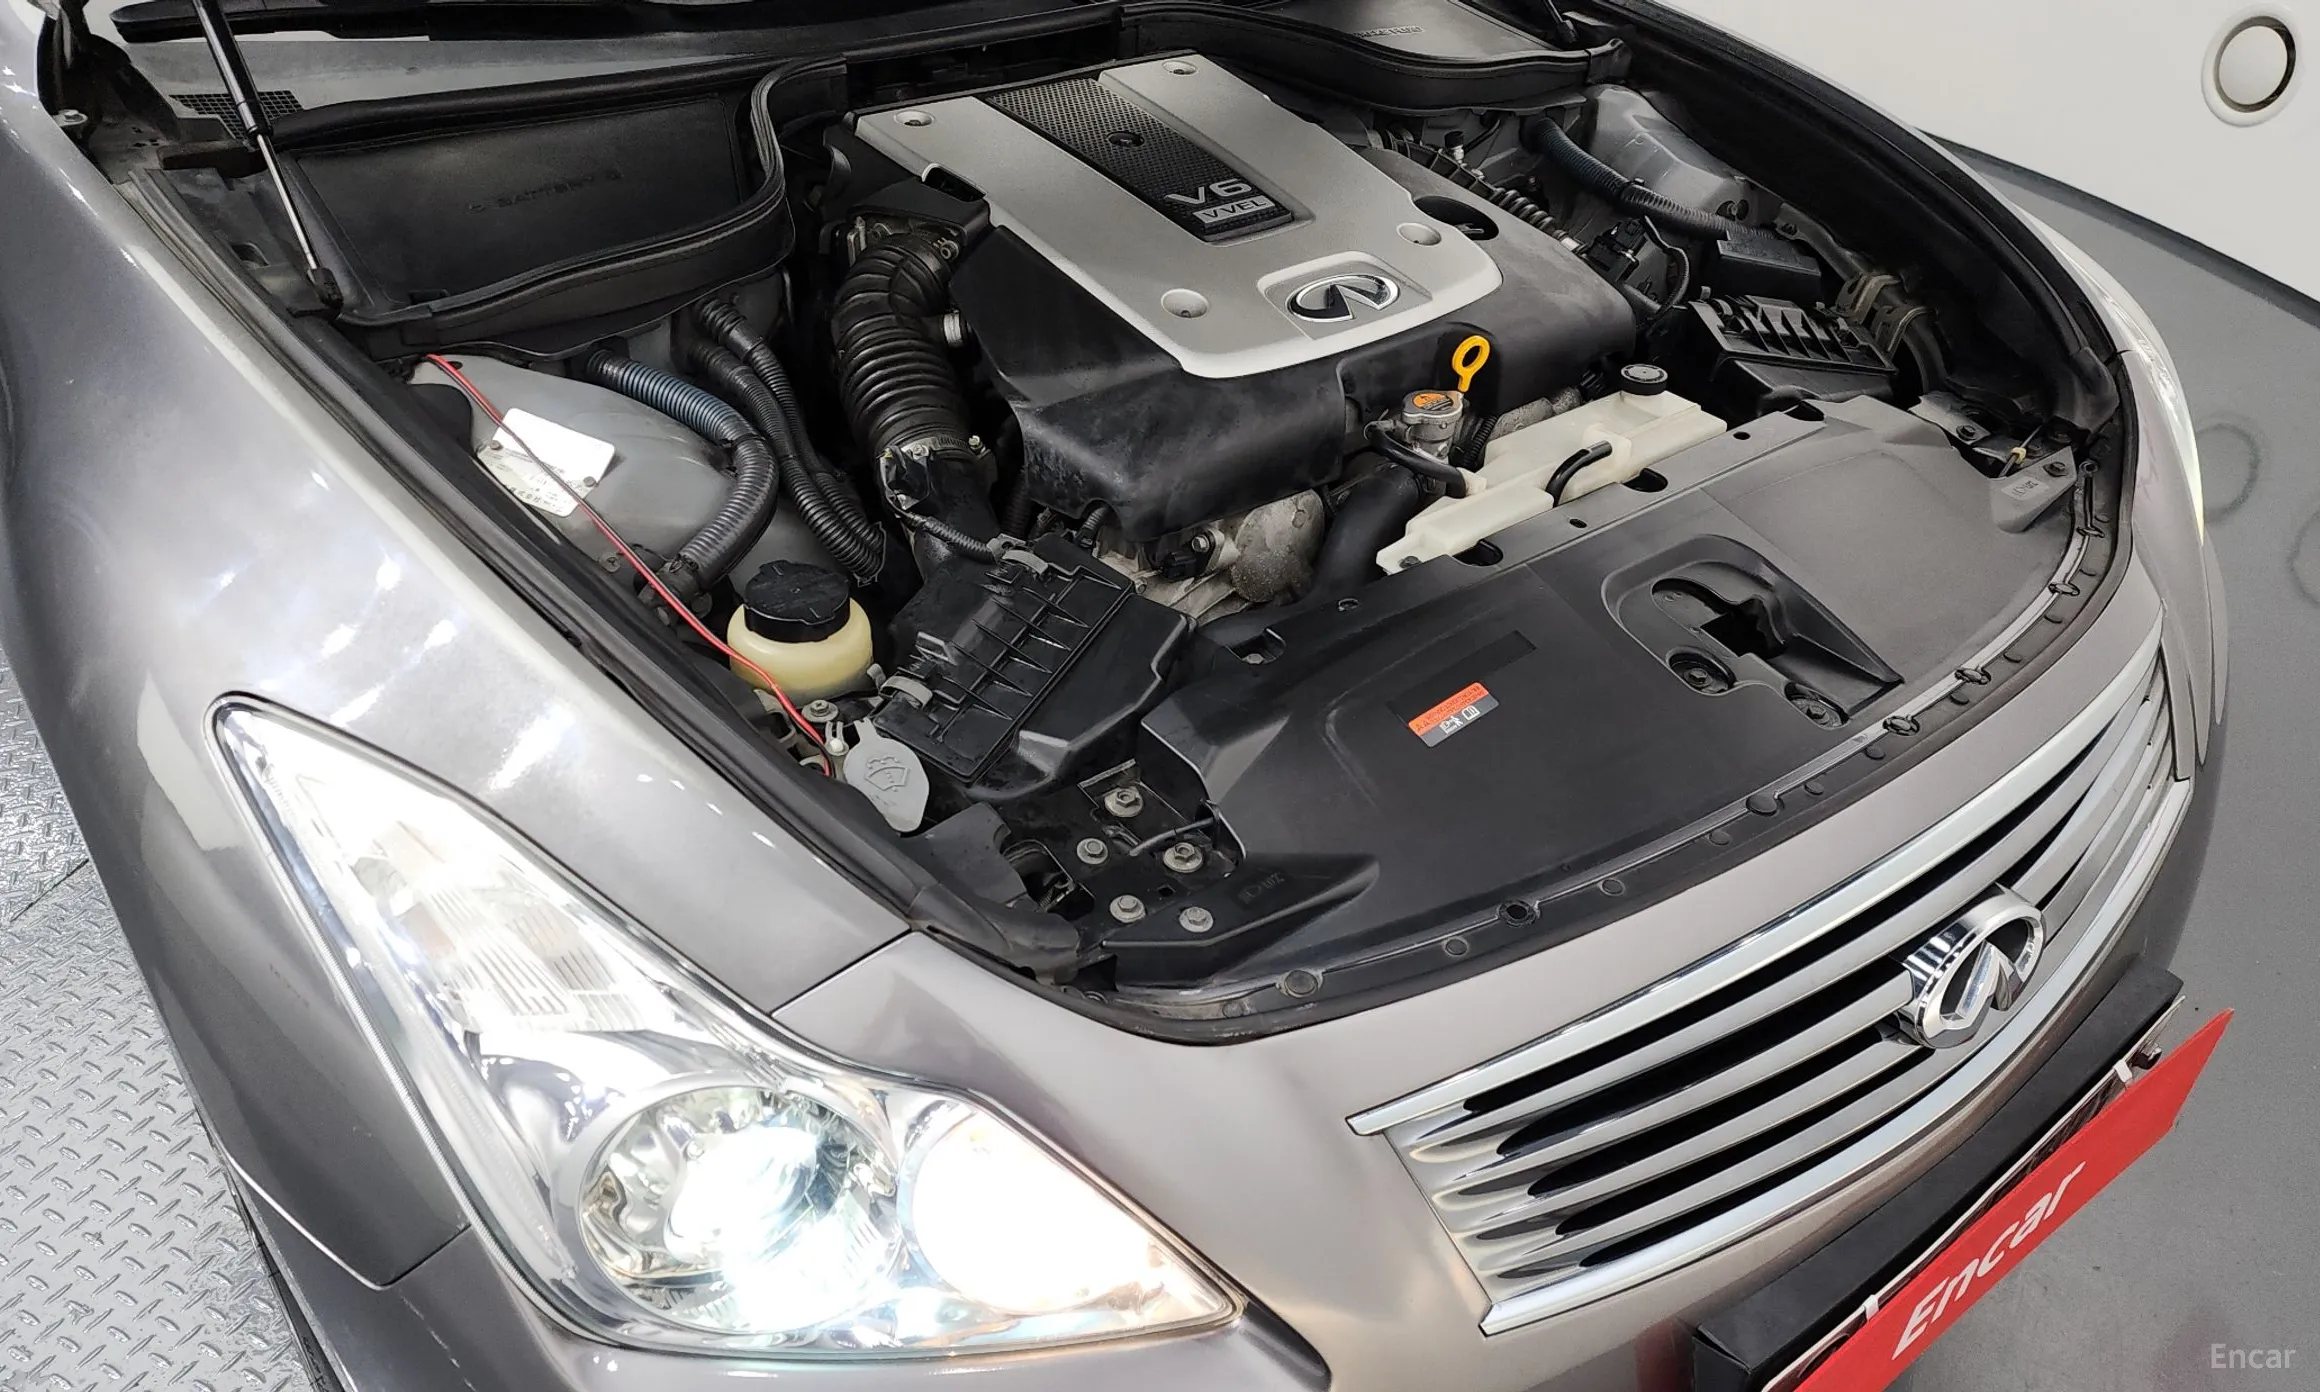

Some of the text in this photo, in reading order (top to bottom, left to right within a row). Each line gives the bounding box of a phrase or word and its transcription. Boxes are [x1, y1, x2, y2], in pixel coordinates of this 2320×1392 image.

[1164, 178, 1252, 205] V6
[1203, 200, 1267, 218] VVEL
[1891, 1160, 2087, 1361] Encar
